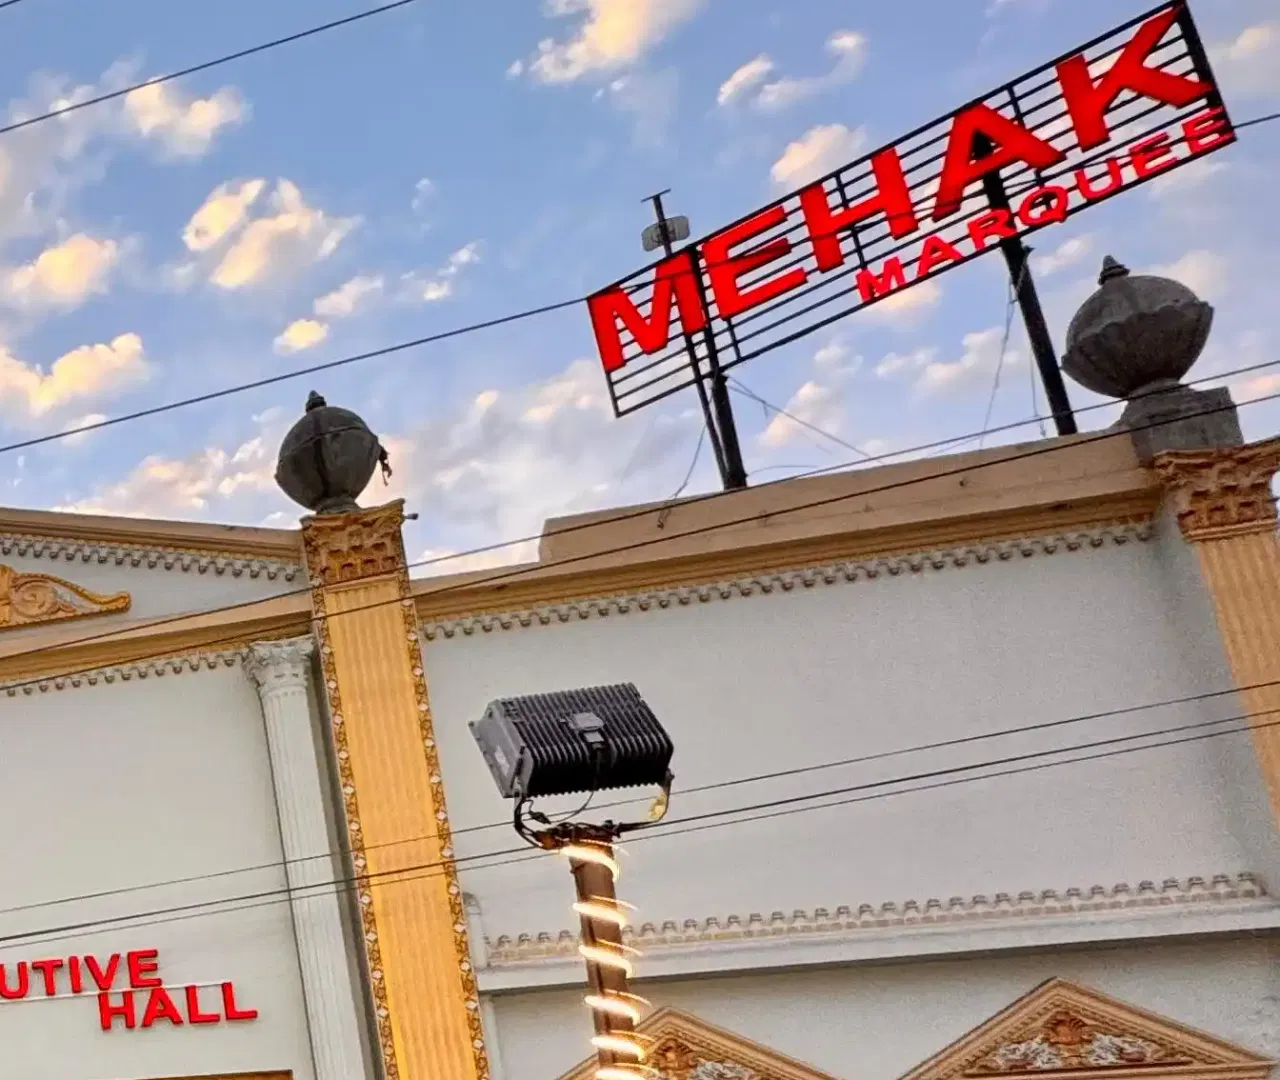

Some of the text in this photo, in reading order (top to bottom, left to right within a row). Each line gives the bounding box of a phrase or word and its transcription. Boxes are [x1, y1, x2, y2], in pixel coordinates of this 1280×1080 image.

[588, 5, 1213, 371] MEHAK
[855, 107, 1235, 303] MARQUEE
[99, 982, 259, 1031] HALL
